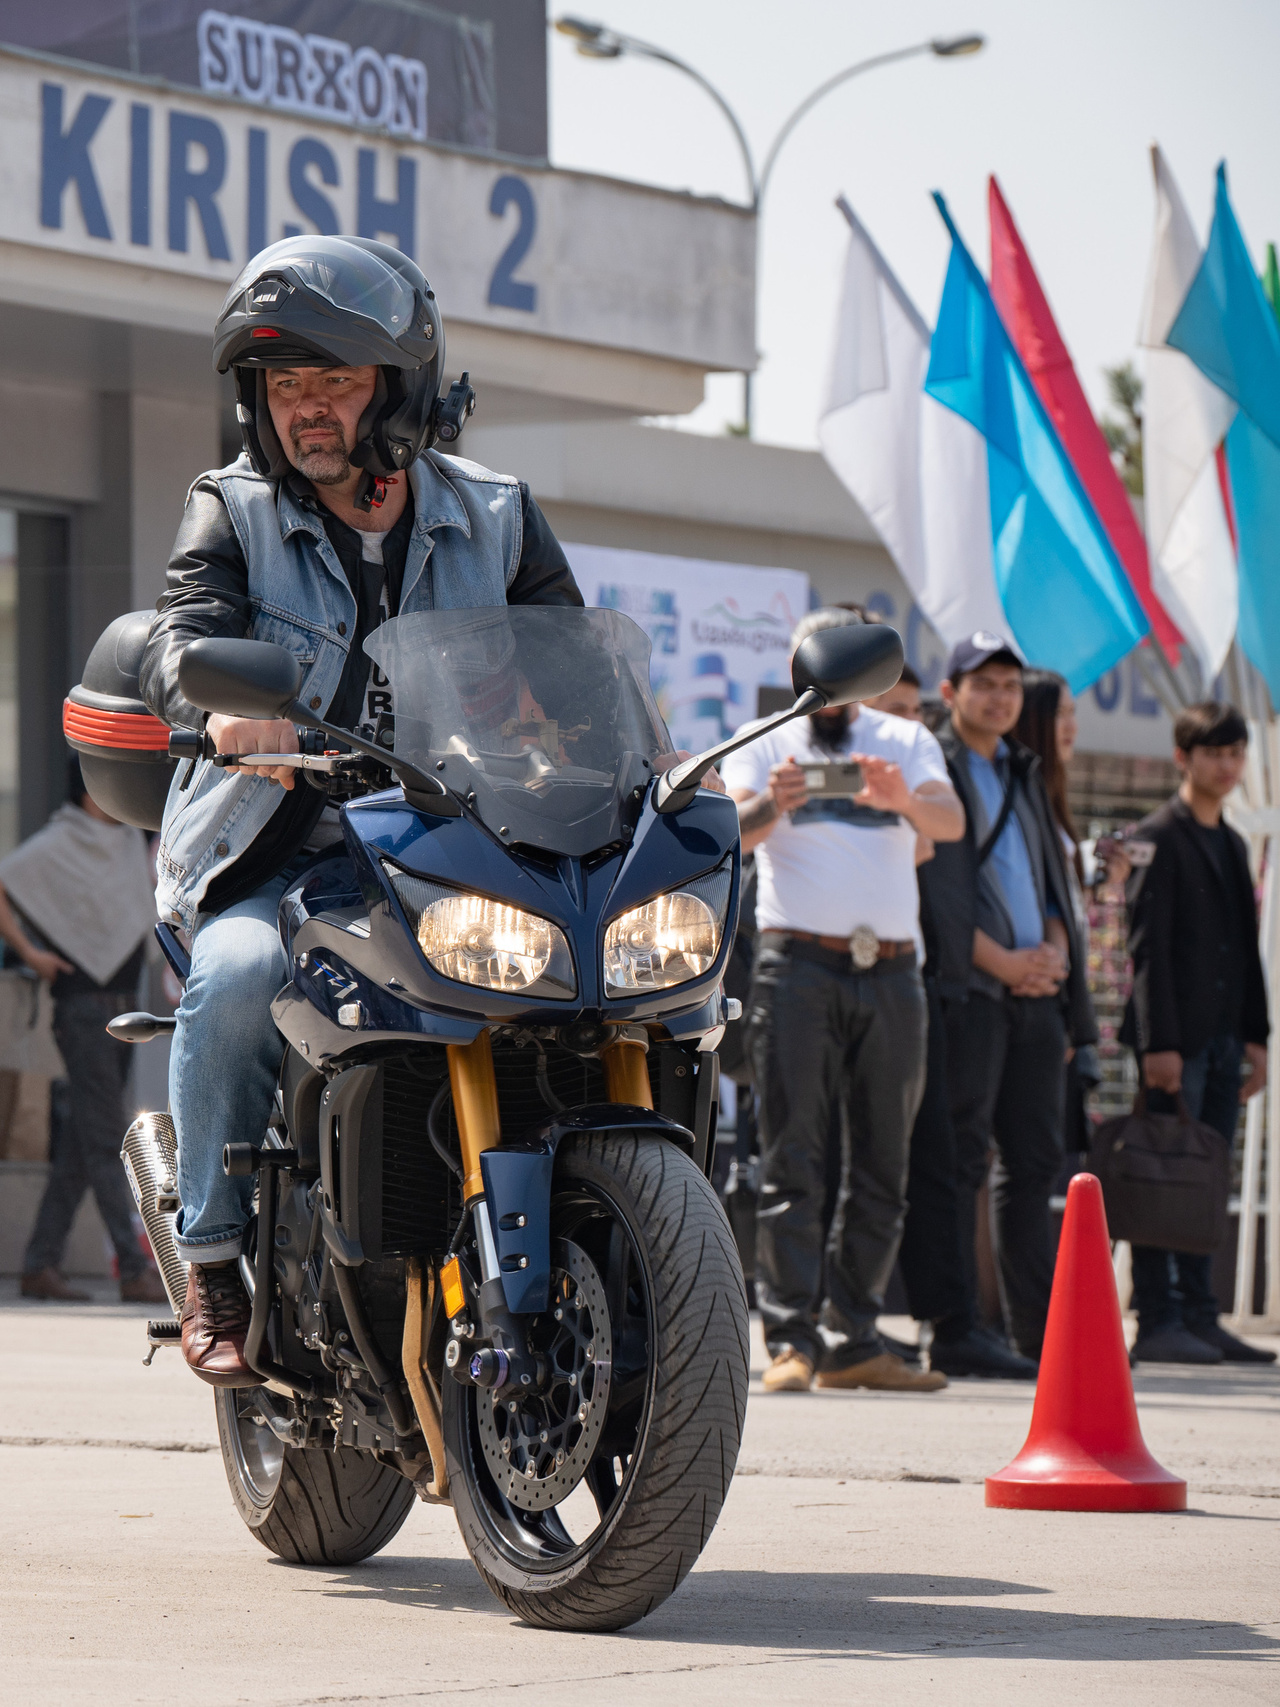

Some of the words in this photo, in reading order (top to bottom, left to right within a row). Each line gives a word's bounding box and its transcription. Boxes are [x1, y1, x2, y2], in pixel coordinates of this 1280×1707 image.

[197, 9, 428, 141] SURXON
[40, 80, 418, 264] KIRISH
[487, 173, 538, 313] 2
